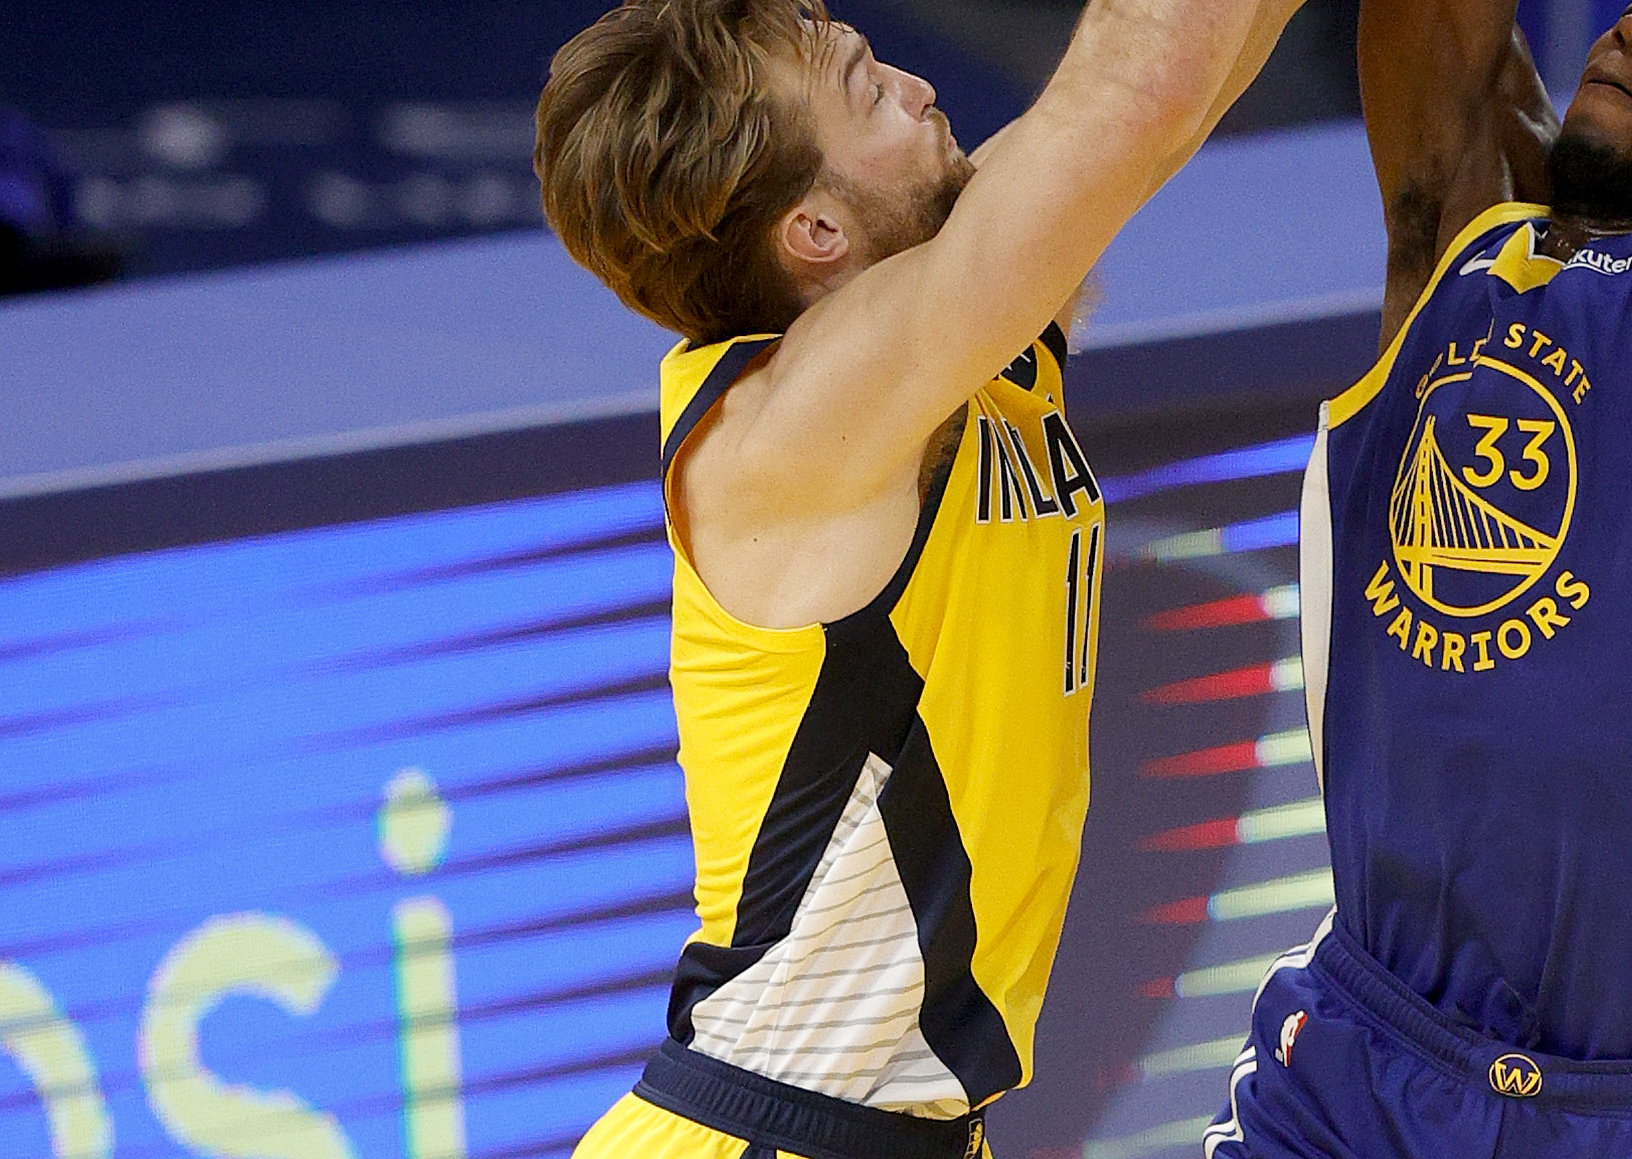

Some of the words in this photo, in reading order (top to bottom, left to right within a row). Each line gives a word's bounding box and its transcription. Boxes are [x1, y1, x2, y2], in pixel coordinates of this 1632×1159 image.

[1503, 321, 1592, 405] STATE
[1462, 413, 1556, 491] 33
[1062, 521, 1101, 698] 11
[1363, 559, 1592, 674] WARRIORS
[0, 768, 470, 1159] si
